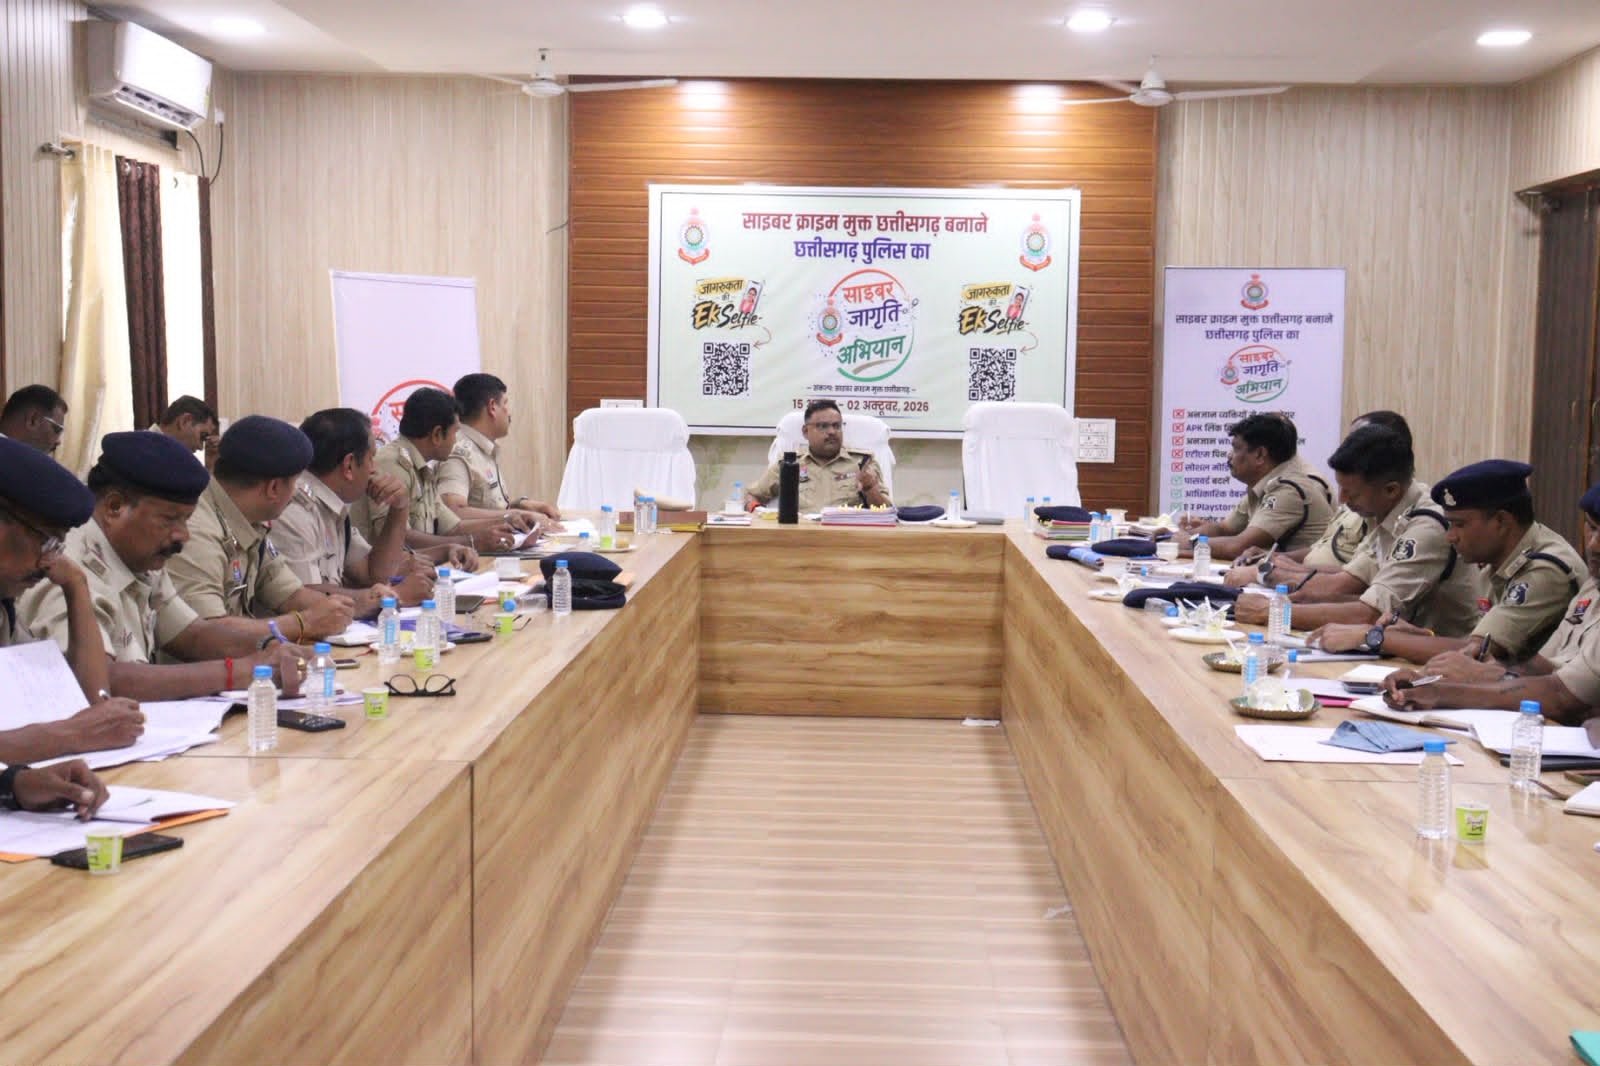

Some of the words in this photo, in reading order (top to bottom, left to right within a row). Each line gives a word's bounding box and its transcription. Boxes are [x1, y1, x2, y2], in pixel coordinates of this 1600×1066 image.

[742, 212, 792, 231] साइबर
[796, 213, 839, 231] क्राइम
[843, 214, 873, 237] मुक्त
[876, 210, 942, 237] छत्तीसगढ़
[944, 211, 989, 233] बनाने
[794, 236, 859, 263] छत्तीसगढ़
[862, 237, 908, 265] पुलिस
[910, 242, 931, 260] का
[842, 280, 896, 304] साइबर
[691, 300, 721, 330] Ek
[716, 303, 758, 330] Selfie
[847, 298, 903, 330] जागृति
[957, 305, 988, 335] Ek
[983, 308, 1025, 335] Selfie
[1176, 314, 1208, 324] साइबर
[1210, 314, 1238, 324] क्राइम
[1240, 314, 1259, 326] मुक्त
[1305, 313, 1333, 324] बनाने
[1252, 327, 1283, 342] पुलिस
[1286, 329, 1299, 340] का
[836, 335, 907, 365] अभियान
[1239, 351, 1274, 363] साइबर
[1242, 360, 1281, 377] जागृति
[1234, 378, 1284, 394] अभियान
[793, 399, 803, 409] 15
[847, 400, 860, 410] 02
[903, 401, 929, 412] 2026
[1186, 424, 1203, 432] APK
